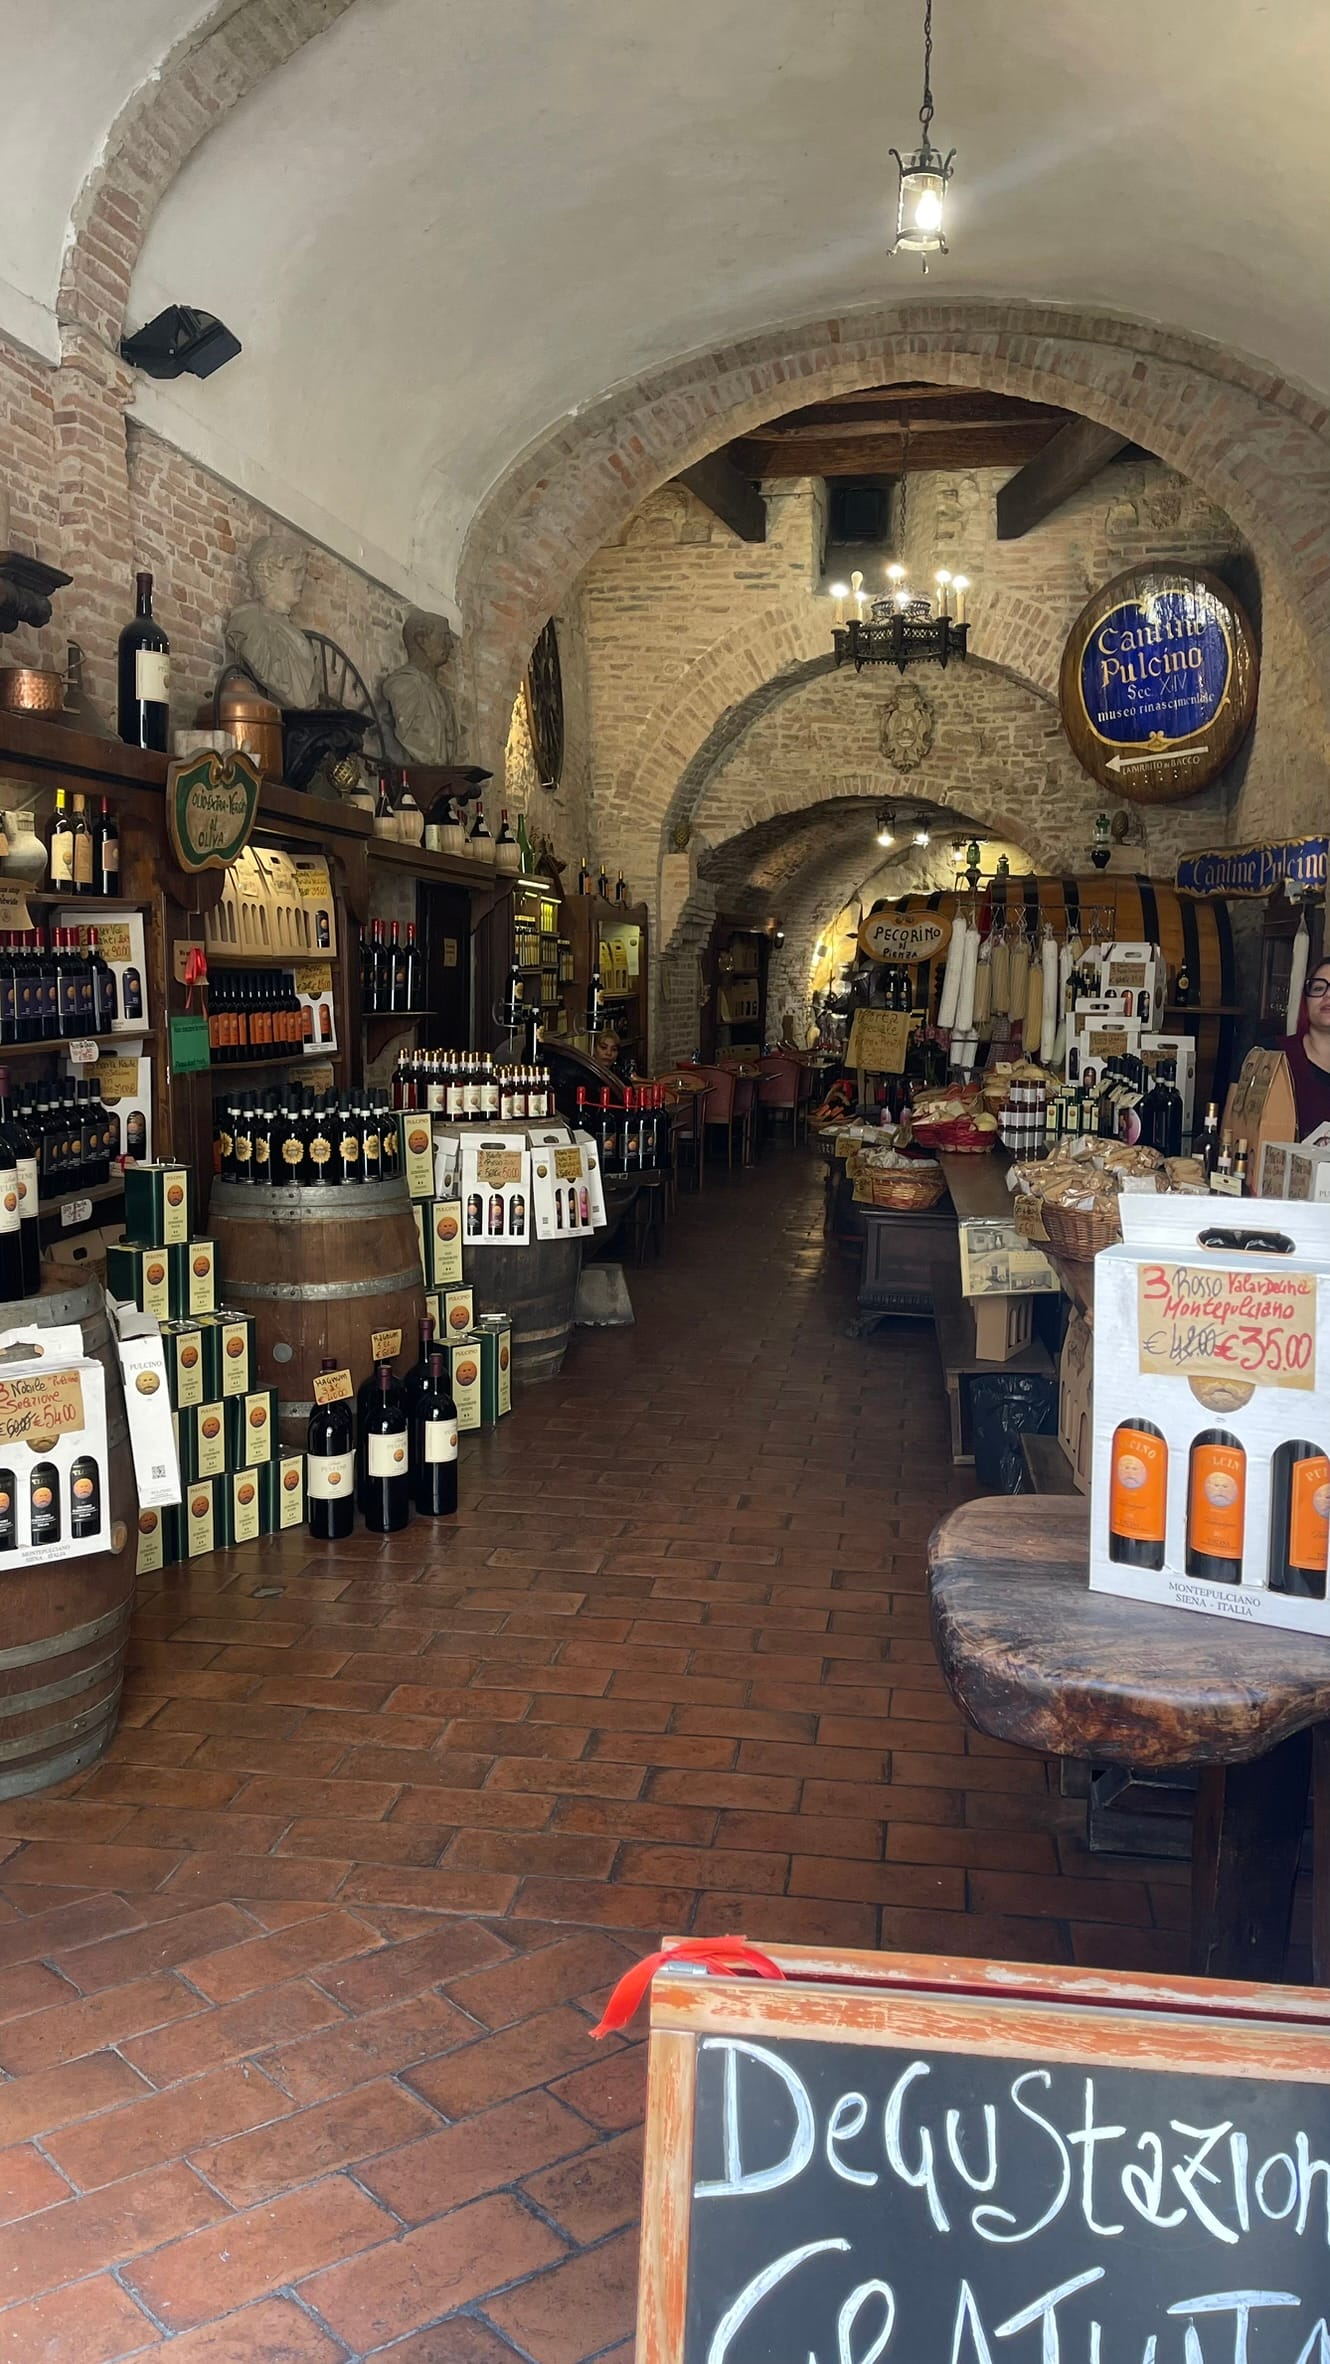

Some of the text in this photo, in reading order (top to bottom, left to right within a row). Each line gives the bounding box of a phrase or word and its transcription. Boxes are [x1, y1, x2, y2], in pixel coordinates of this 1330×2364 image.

[1101, 646, 1203, 688] Pulcino
[1098, 705, 1137, 723] museo
[1193, 858, 1257, 886] Cantine
[1143, 1265, 1171, 1300] 3
[1172, 1266, 1223, 1298] Rosso
[1162, 1295, 1295, 1325] Montepulciano
[129, 1360, 163, 1371] PULCINO
[11, 1377, 48, 1398] Nobile
[1168, 1581, 1261, 1607] MONTEPULCIANO
[1175, 1594, 1253, 1616] SIENA ITALIA
